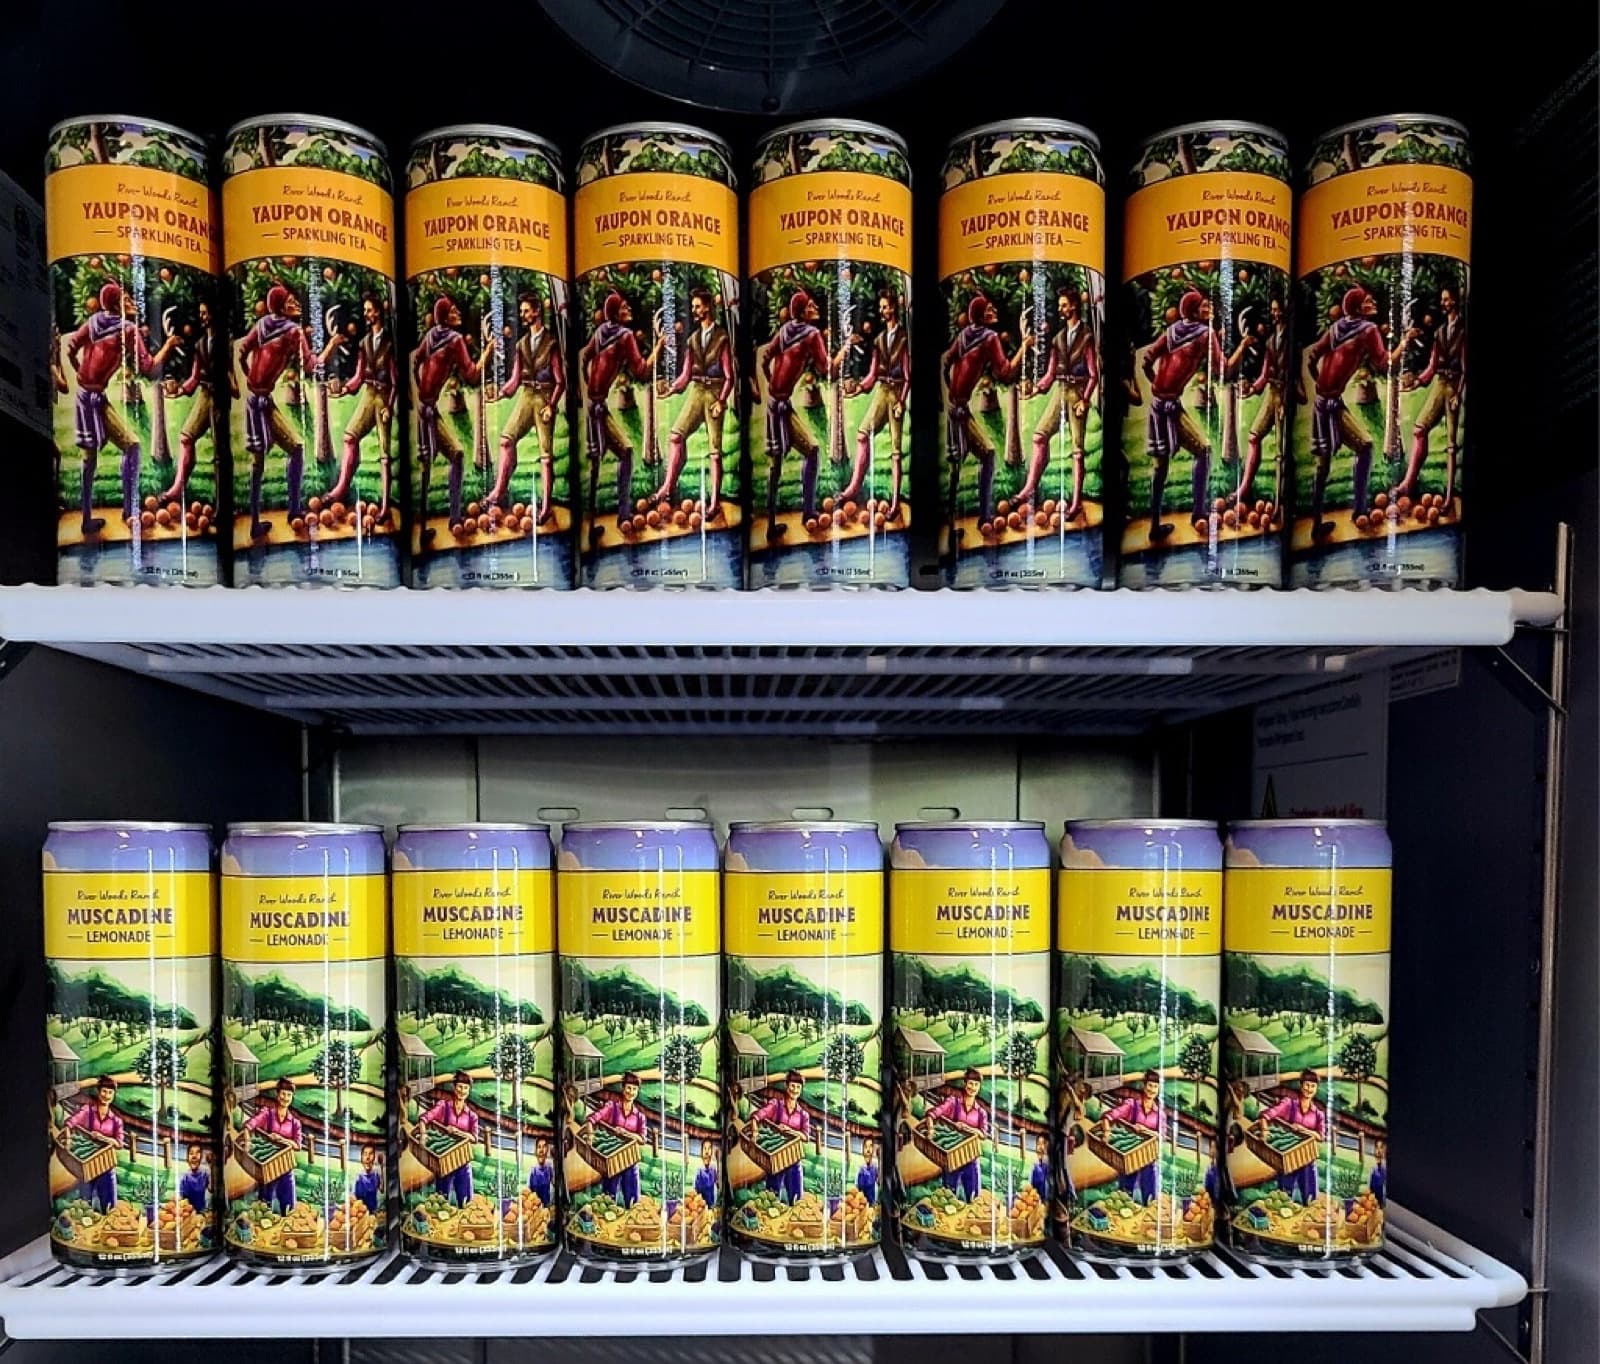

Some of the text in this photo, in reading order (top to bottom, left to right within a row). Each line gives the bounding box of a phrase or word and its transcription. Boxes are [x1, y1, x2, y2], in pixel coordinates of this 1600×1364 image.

[83, 203, 216, 241] YAUPON ORAN
[253, 204, 388, 243] YAUPON ORANGE
[595, 209, 720, 235] YAUPON ORANGE
[780, 209, 904, 237] YAUPON ORANGE
[961, 209, 1089, 236] YAUPON ORANGE
[1331, 201, 1468, 230] YAUPON ORANGE
[424, 215, 550, 240] YAUPON ORANGE
[1166, 209, 1290, 240] YAUPON ORANG
[1431, 226, 1447, 240] TEA
[117, 226, 201, 253] SPARKLING TEA
[283, 227, 366, 251] SPARKLING TEA
[446, 237, 522, 252] SPARKLING TEA
[619, 233, 694, 247] SPARKLING TEA
[806, 232, 883, 248] SPARKLING TEA
[986, 232, 1063, 249] SPARKLING TEA
[1200, 231, 1276, 249] SPARKLING TEA
[68, 908, 172, 925] MUSCADINE
[250, 912, 349, 928] MUSCADINE
[424, 906, 522, 922] MUSCADINE
[592, 906, 692, 923] MUSCADINE
[758, 907, 855, 924] MUSCADINE
[937, 905, 1030, 920] MUSCADINE
[1116, 906, 1209, 921] MUSCADINE
[1272, 905, 1372, 920] MUSCADINE
[87, 931, 151, 942] LEMONADE
[444, 928, 503, 939] LEMONADE
[778, 930, 836, 941] LEMONADE
[1138, 928, 1194, 939] LEMONADE
[1294, 927, 1355, 938] LEMONADE
